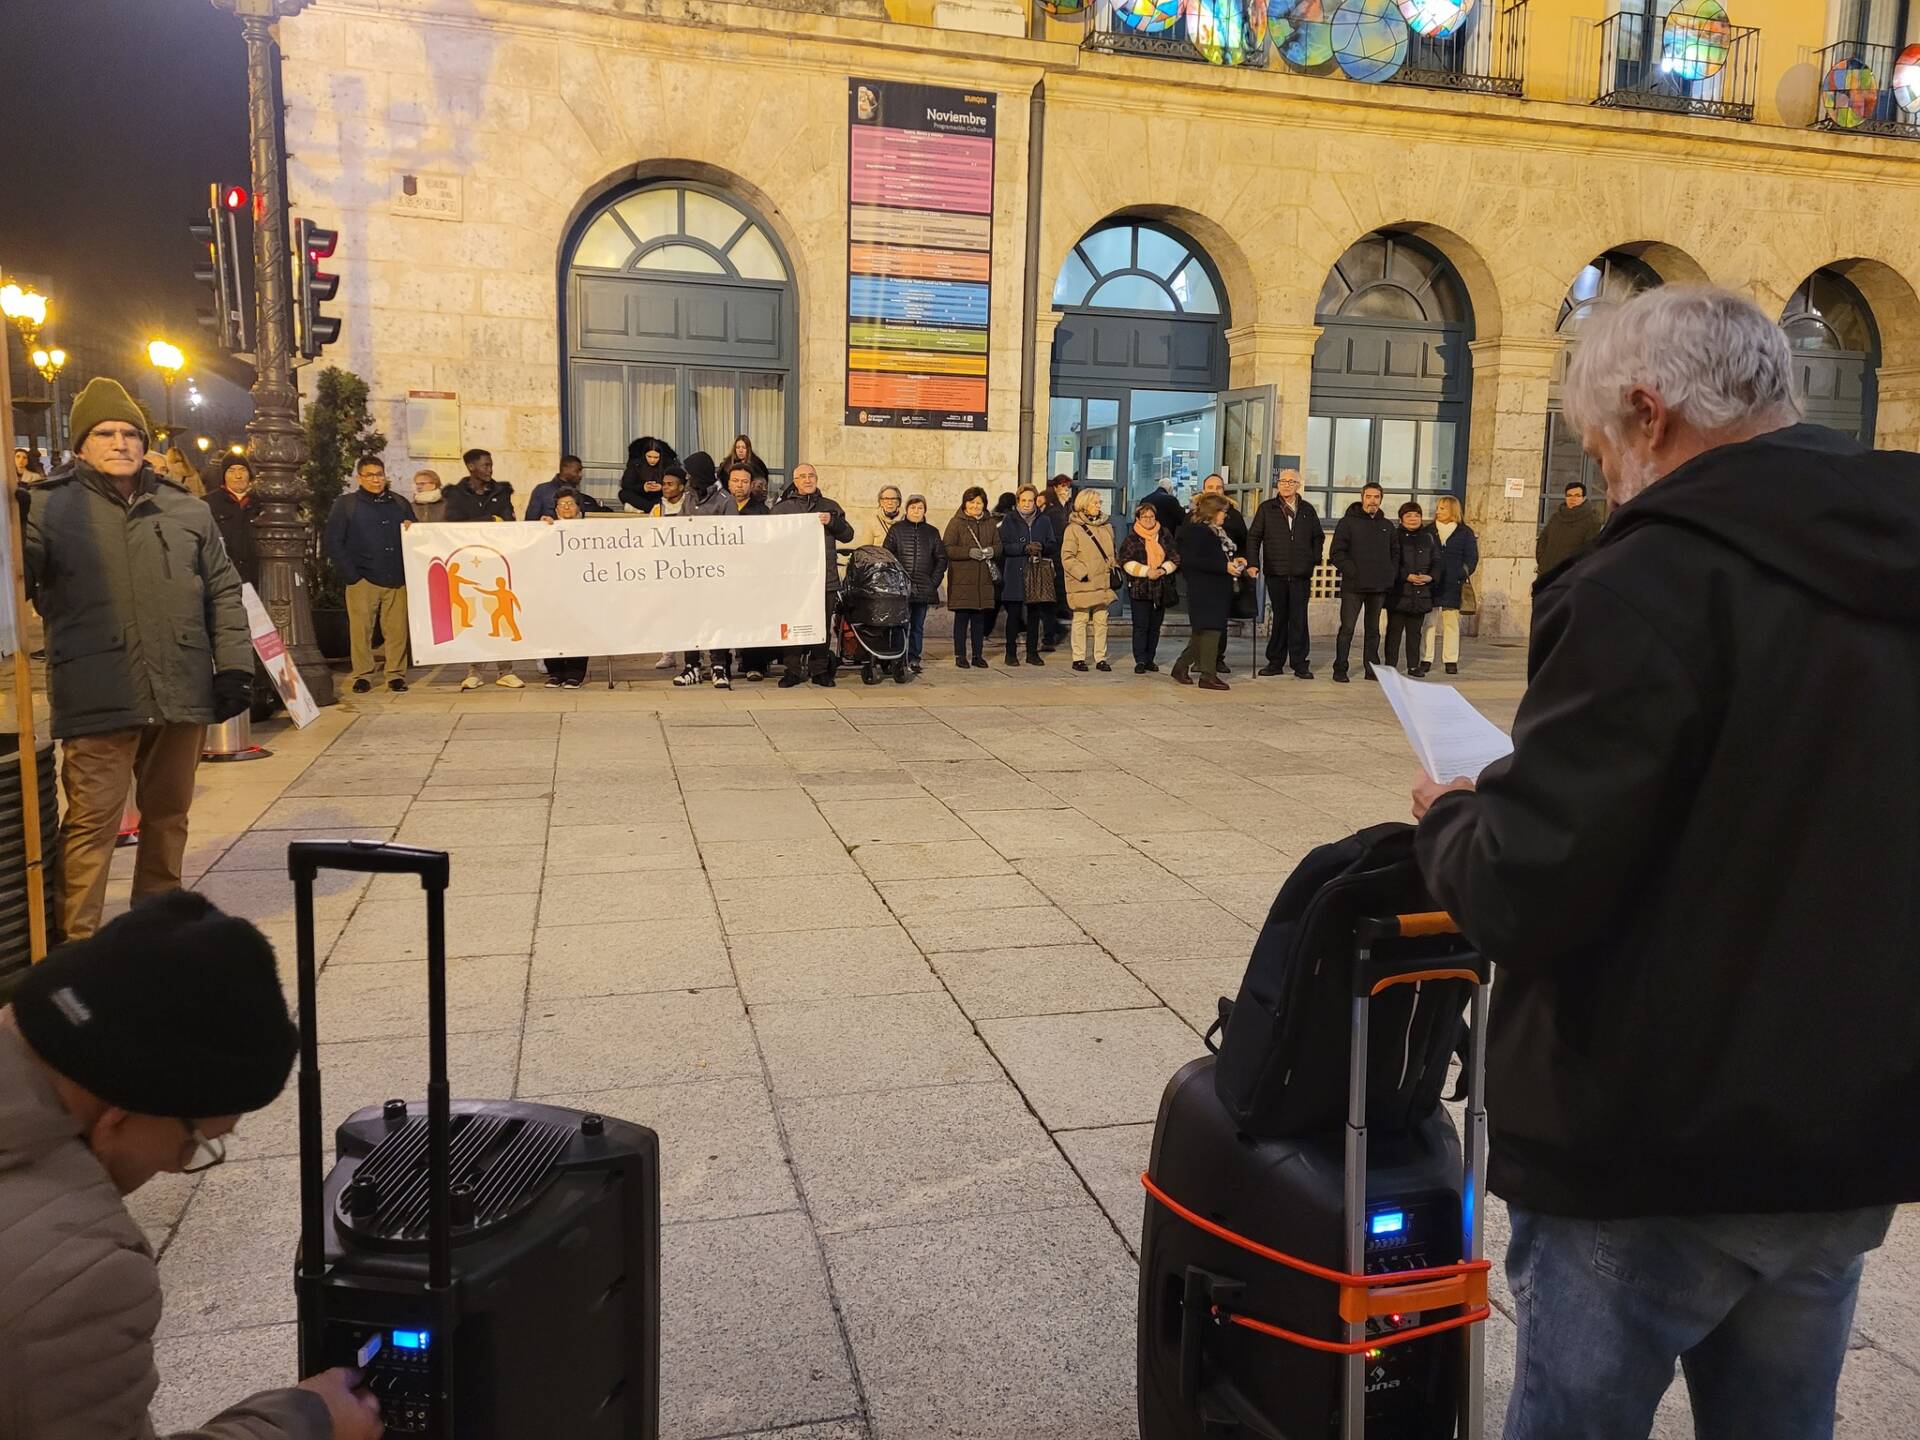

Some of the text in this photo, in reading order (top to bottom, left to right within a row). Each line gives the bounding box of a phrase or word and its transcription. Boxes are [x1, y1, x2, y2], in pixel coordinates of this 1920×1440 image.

[926, 107, 986, 126] Noviembre
[966, 125, 986, 133] Cultural
[556, 525, 746, 557] Jornada Mundial
[583, 559, 725, 583] de los Pobres
[1365, 1379, 1401, 1393] una
